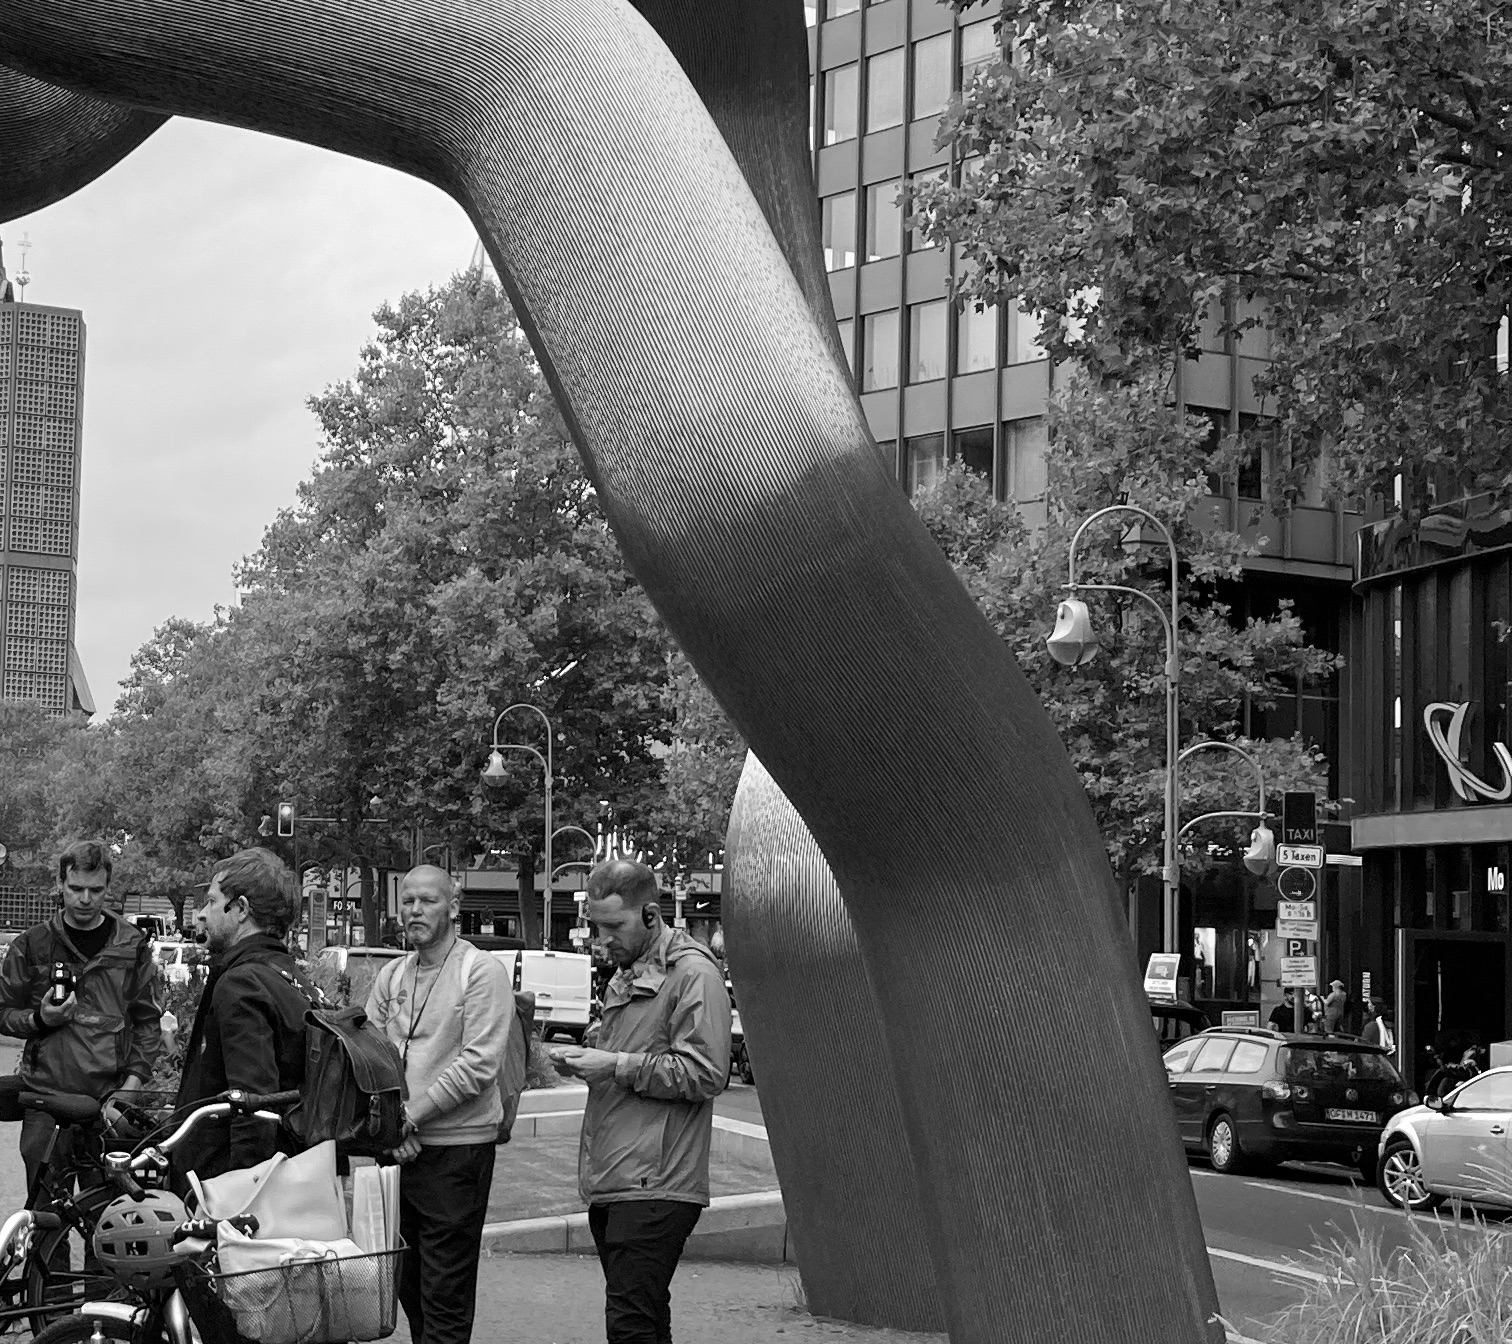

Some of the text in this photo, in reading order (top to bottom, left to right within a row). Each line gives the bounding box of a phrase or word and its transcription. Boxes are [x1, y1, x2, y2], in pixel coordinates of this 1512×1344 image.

[1286, 828, 1314, 841] TAXI
[1291, 850, 1316, 862] Taxen
[1289, 940, 1302, 956] P
